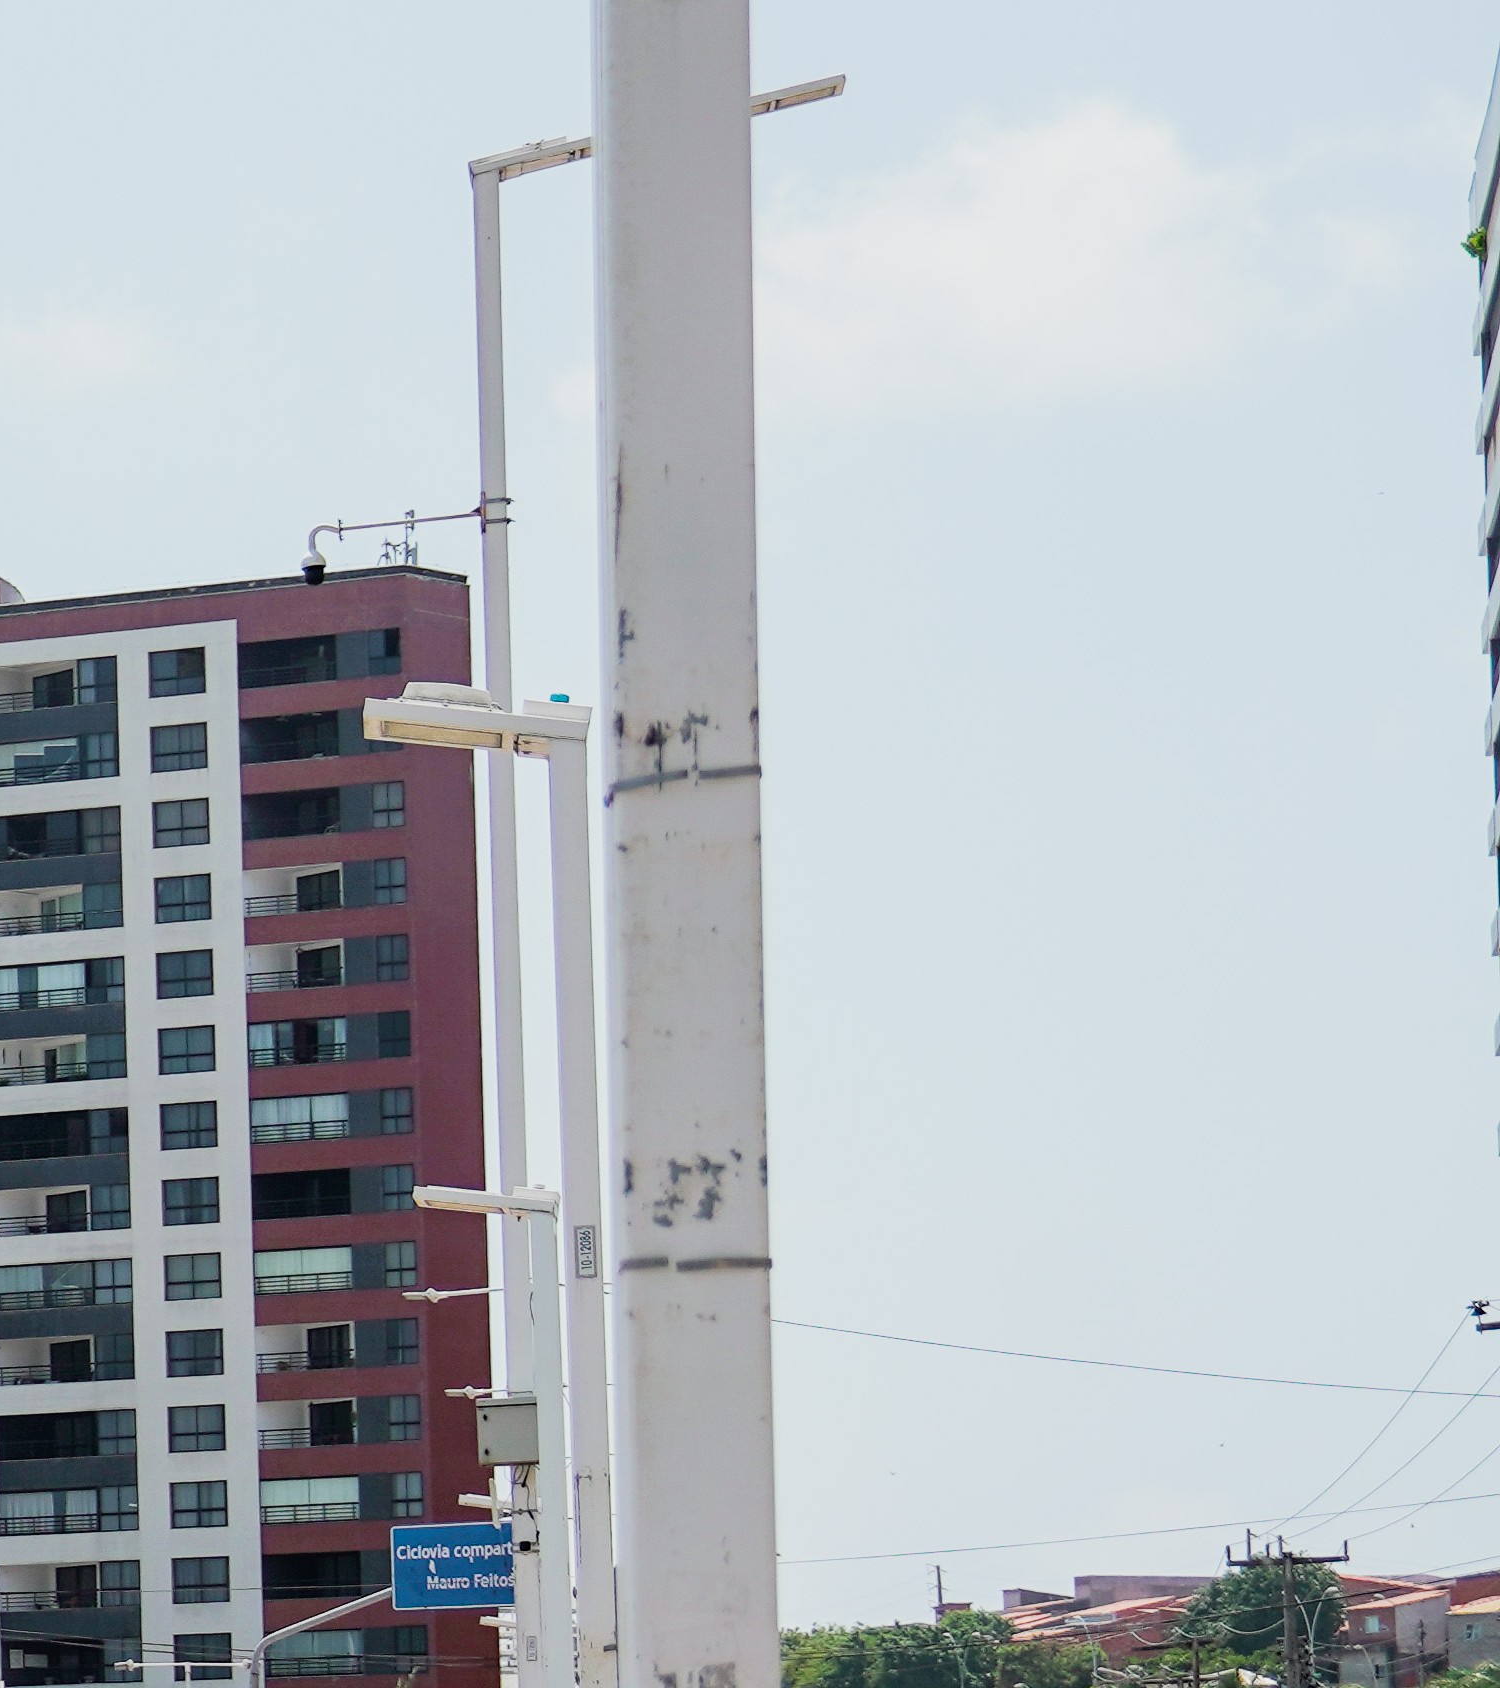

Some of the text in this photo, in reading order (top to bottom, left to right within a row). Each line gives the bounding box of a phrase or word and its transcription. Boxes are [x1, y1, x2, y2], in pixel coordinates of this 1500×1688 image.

[396, 1541, 513, 1560] Ciclovia compart
[426, 1572, 515, 1590] Mauro Feitos
